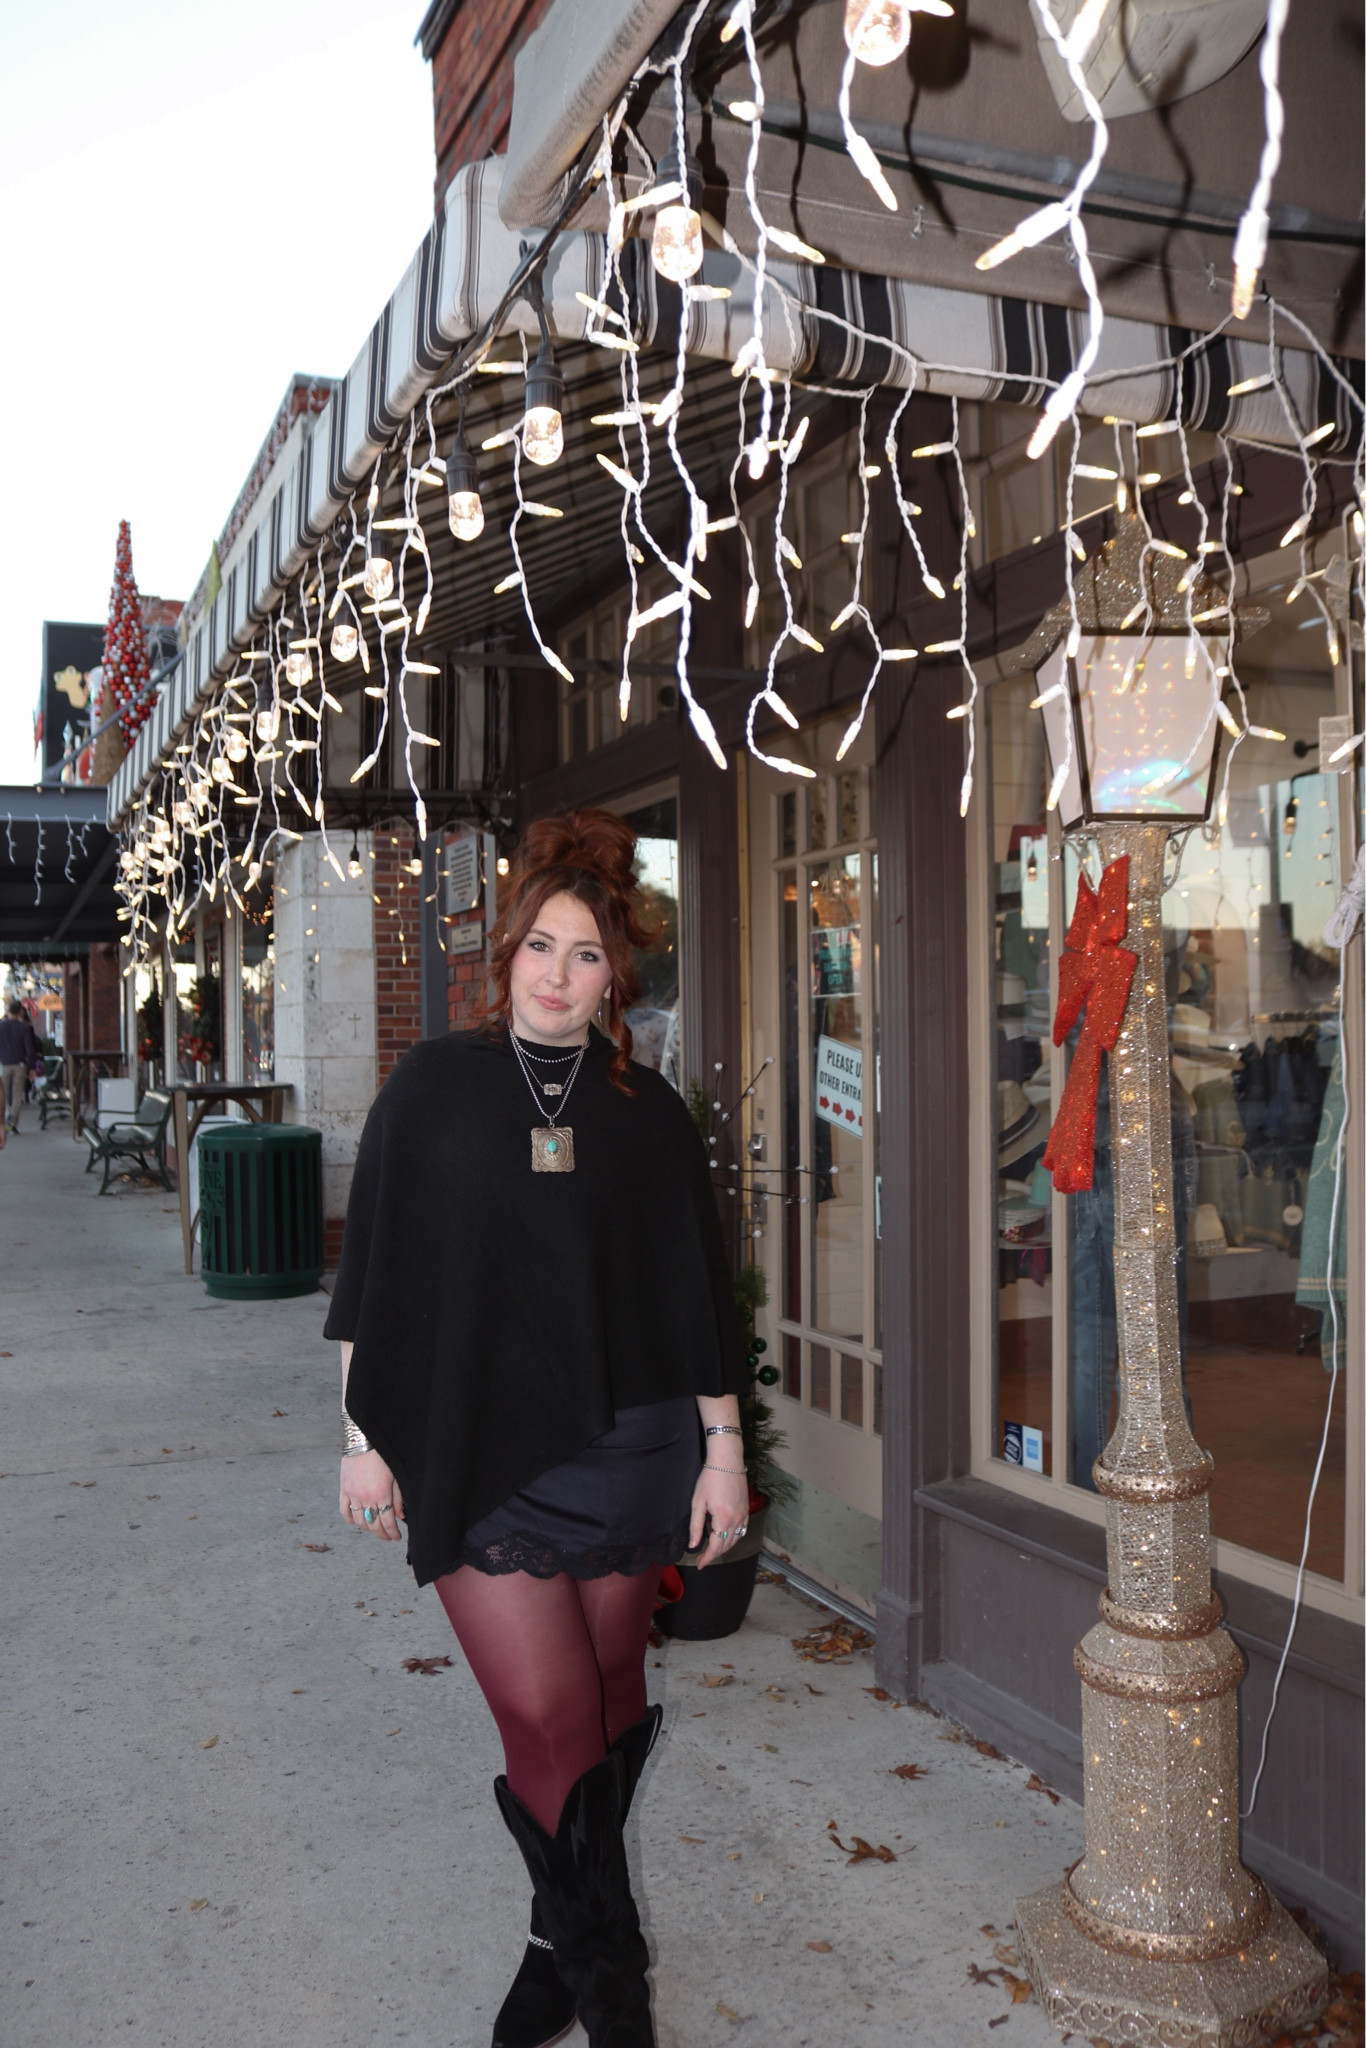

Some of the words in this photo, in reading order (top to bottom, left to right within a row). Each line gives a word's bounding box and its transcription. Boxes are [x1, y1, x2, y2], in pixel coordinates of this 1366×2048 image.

[827, 1049, 854, 1075] PLEASE
[856, 1061, 863, 1079] U
[819, 1070, 840, 1091] OTHER
